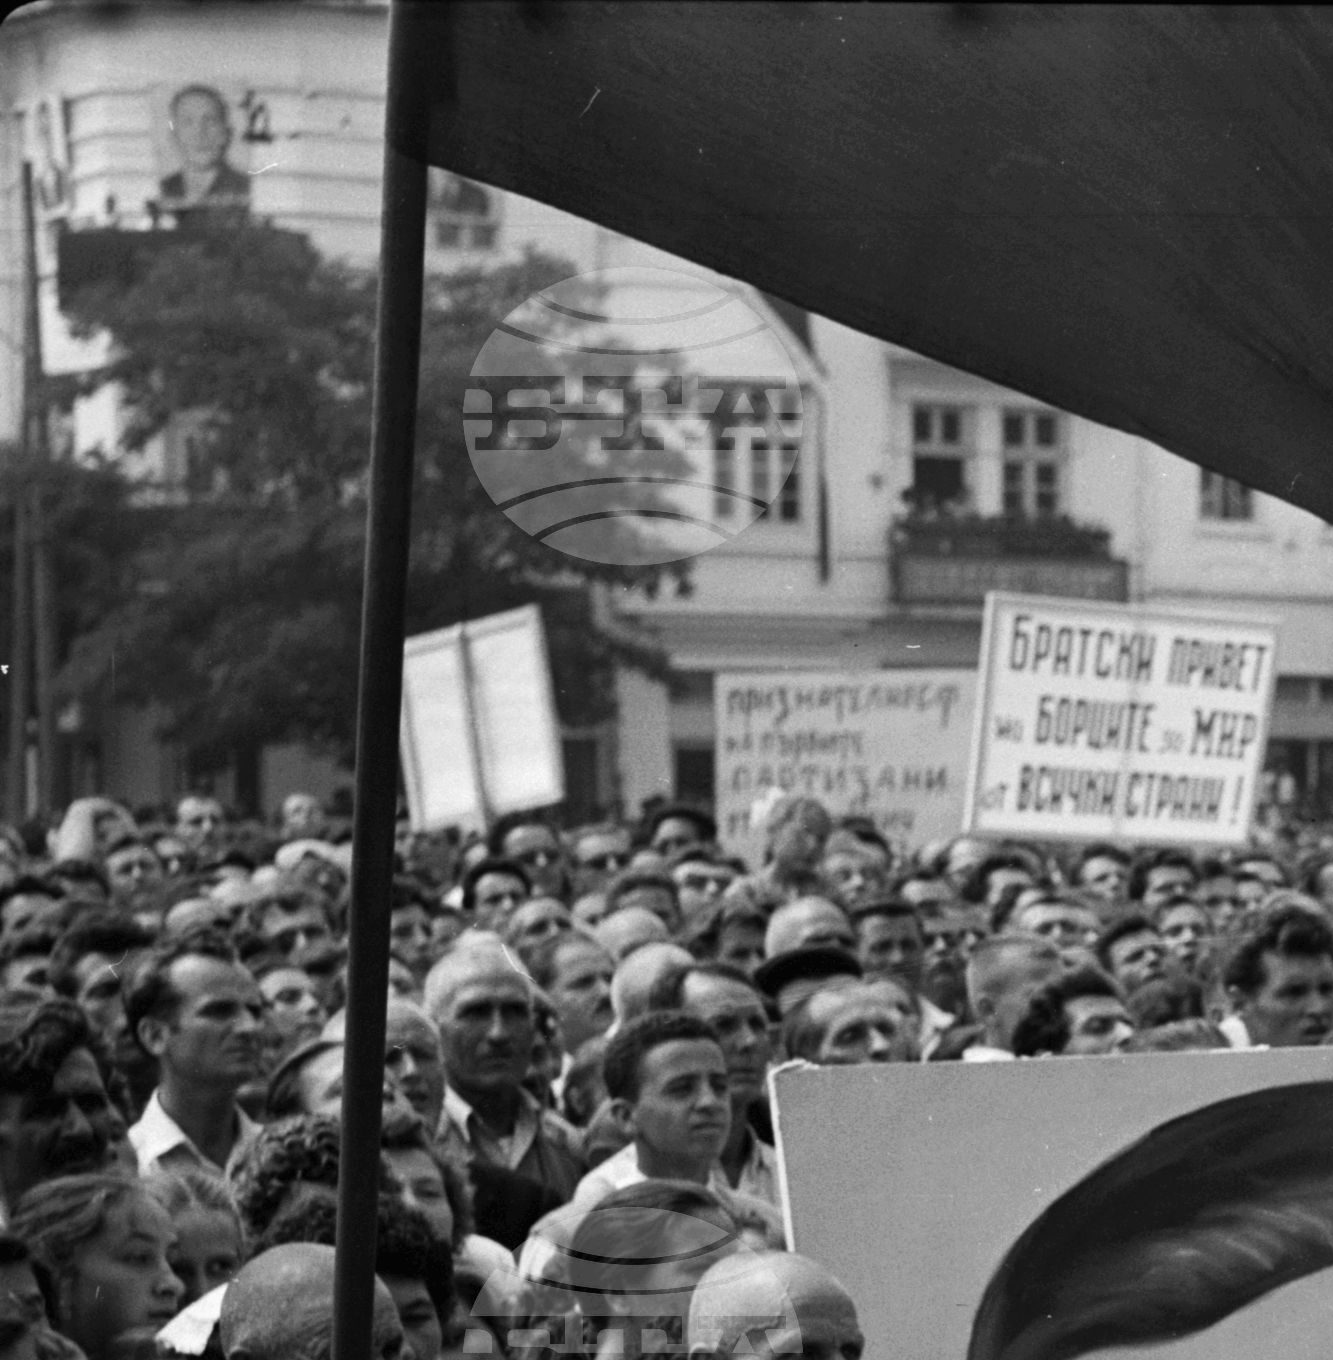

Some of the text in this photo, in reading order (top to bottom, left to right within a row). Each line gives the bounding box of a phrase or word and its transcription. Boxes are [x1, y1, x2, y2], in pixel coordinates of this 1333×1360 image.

[1010, 614, 1268, 692] БРАТСКИ ПРИВЕТ
[1035, 696, 1156, 754] БОРЦИТЕ
[1189, 708, 1258, 760] МИР
[1016, 763, 1122, 816] ВСИЧКИ
